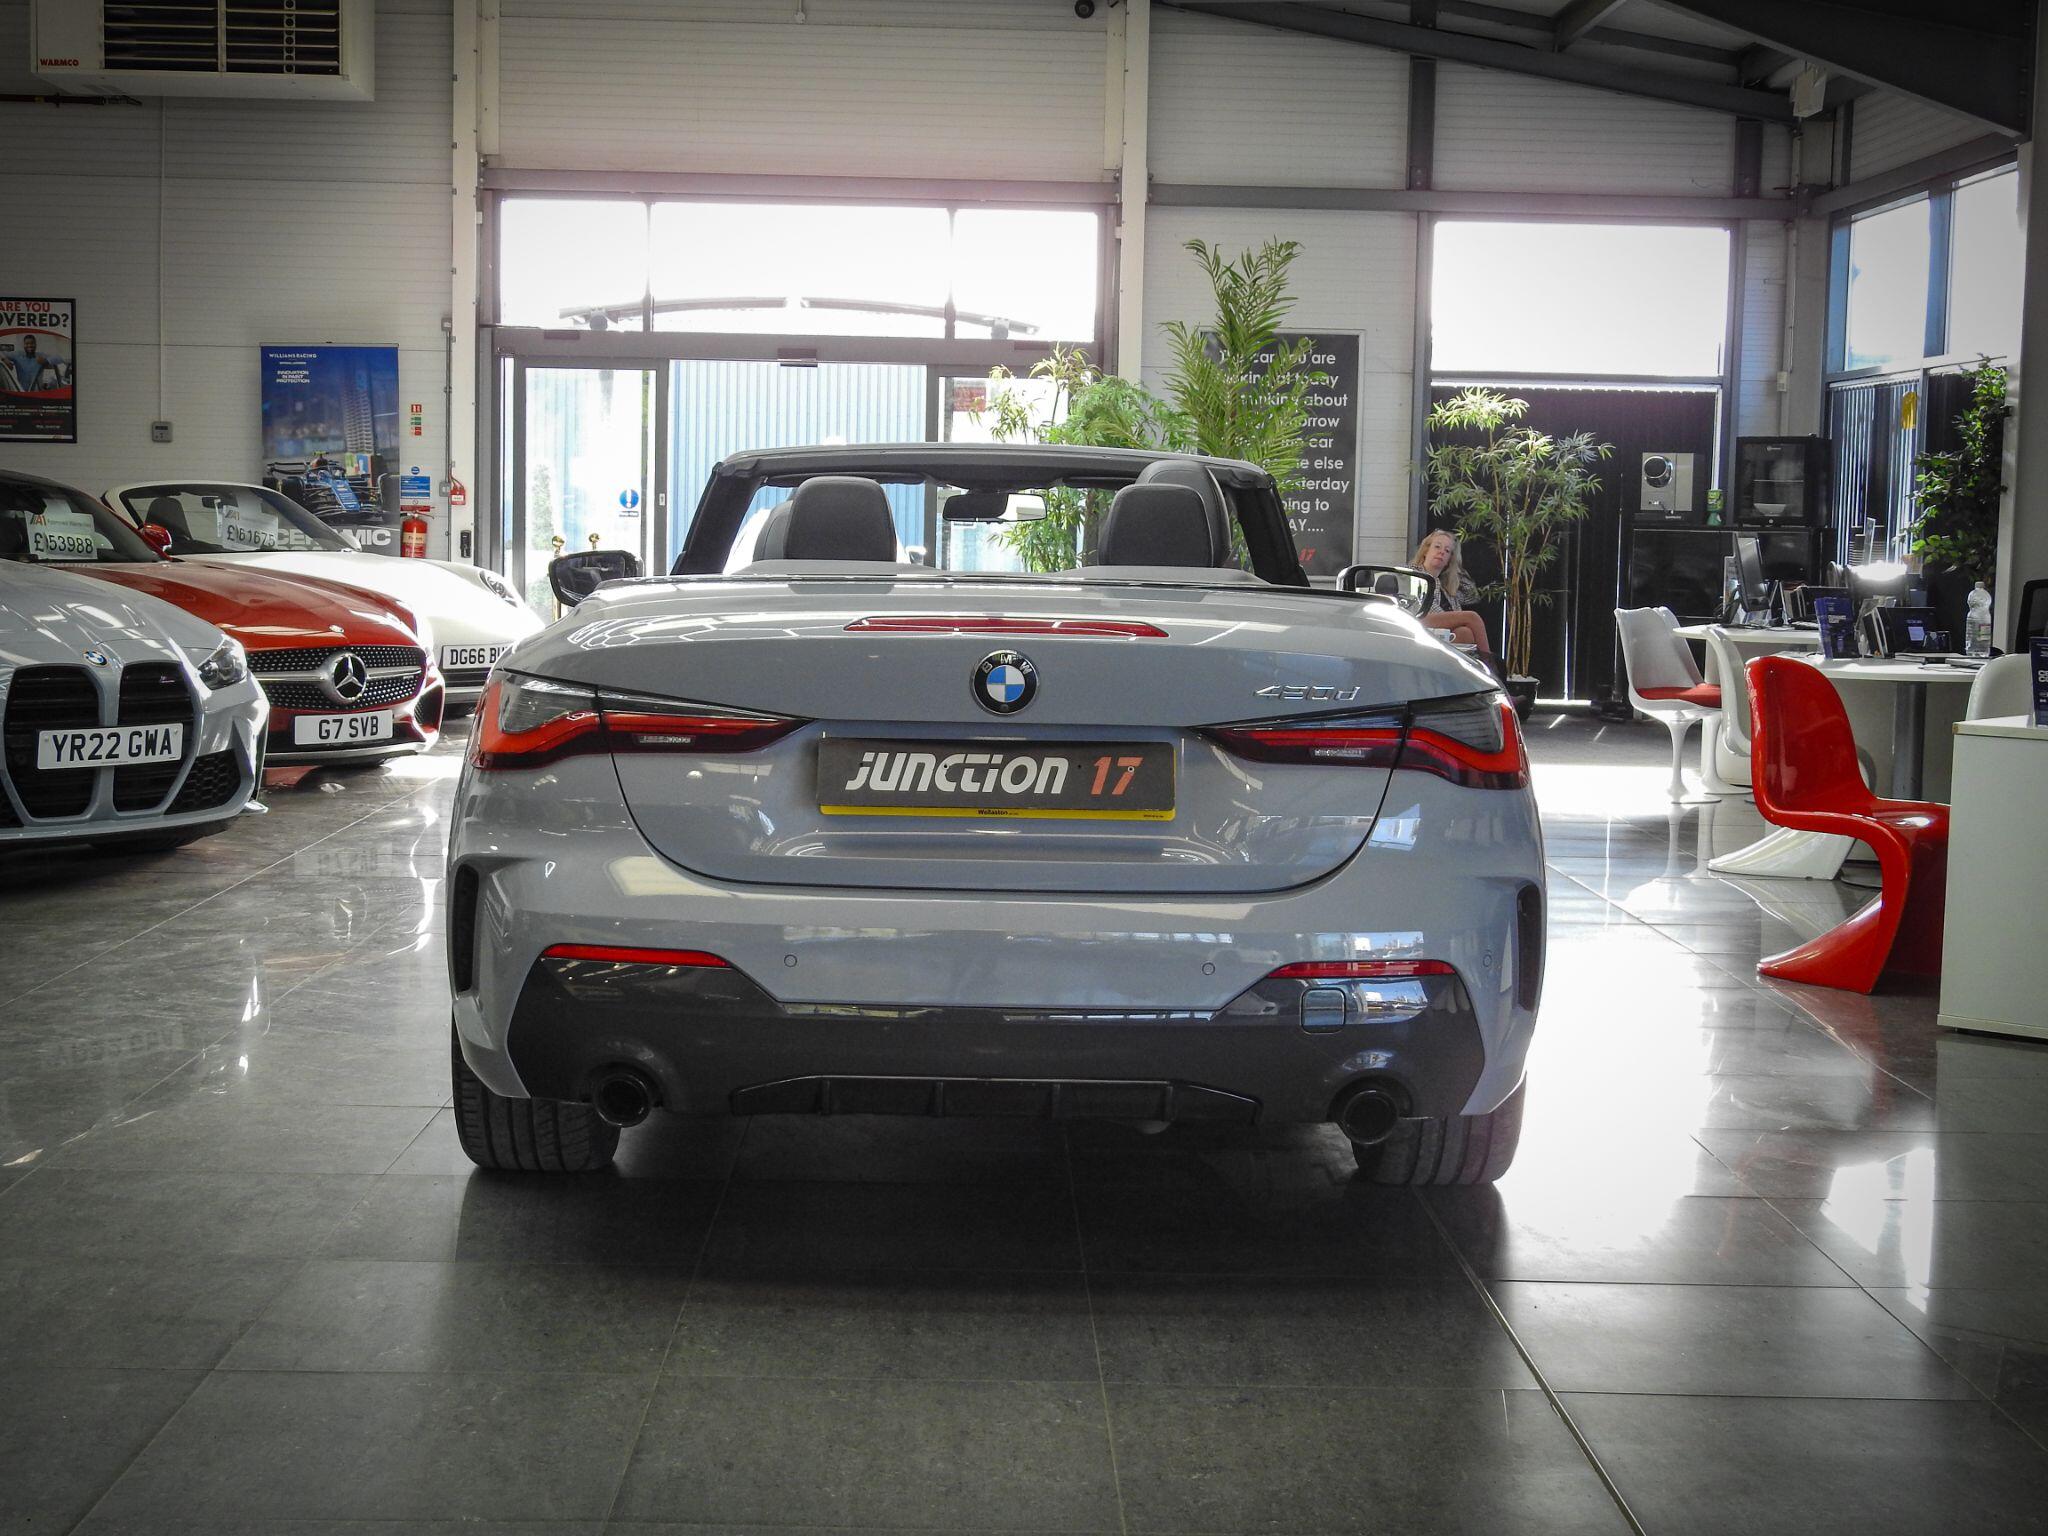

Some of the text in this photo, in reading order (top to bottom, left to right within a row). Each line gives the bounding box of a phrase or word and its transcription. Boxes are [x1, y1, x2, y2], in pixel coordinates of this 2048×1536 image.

[25, 303, 50, 312] YOU
[1311, 354, 1336, 364] are
[1313, 456, 1344, 469] else
[1315, 498, 1330, 511] to
[449, 648, 486, 666] DG66
[318, 715, 379, 739] G7 SVB
[52, 728, 172, 762] YR22 GWA
[1090, 757, 1144, 795] 17
